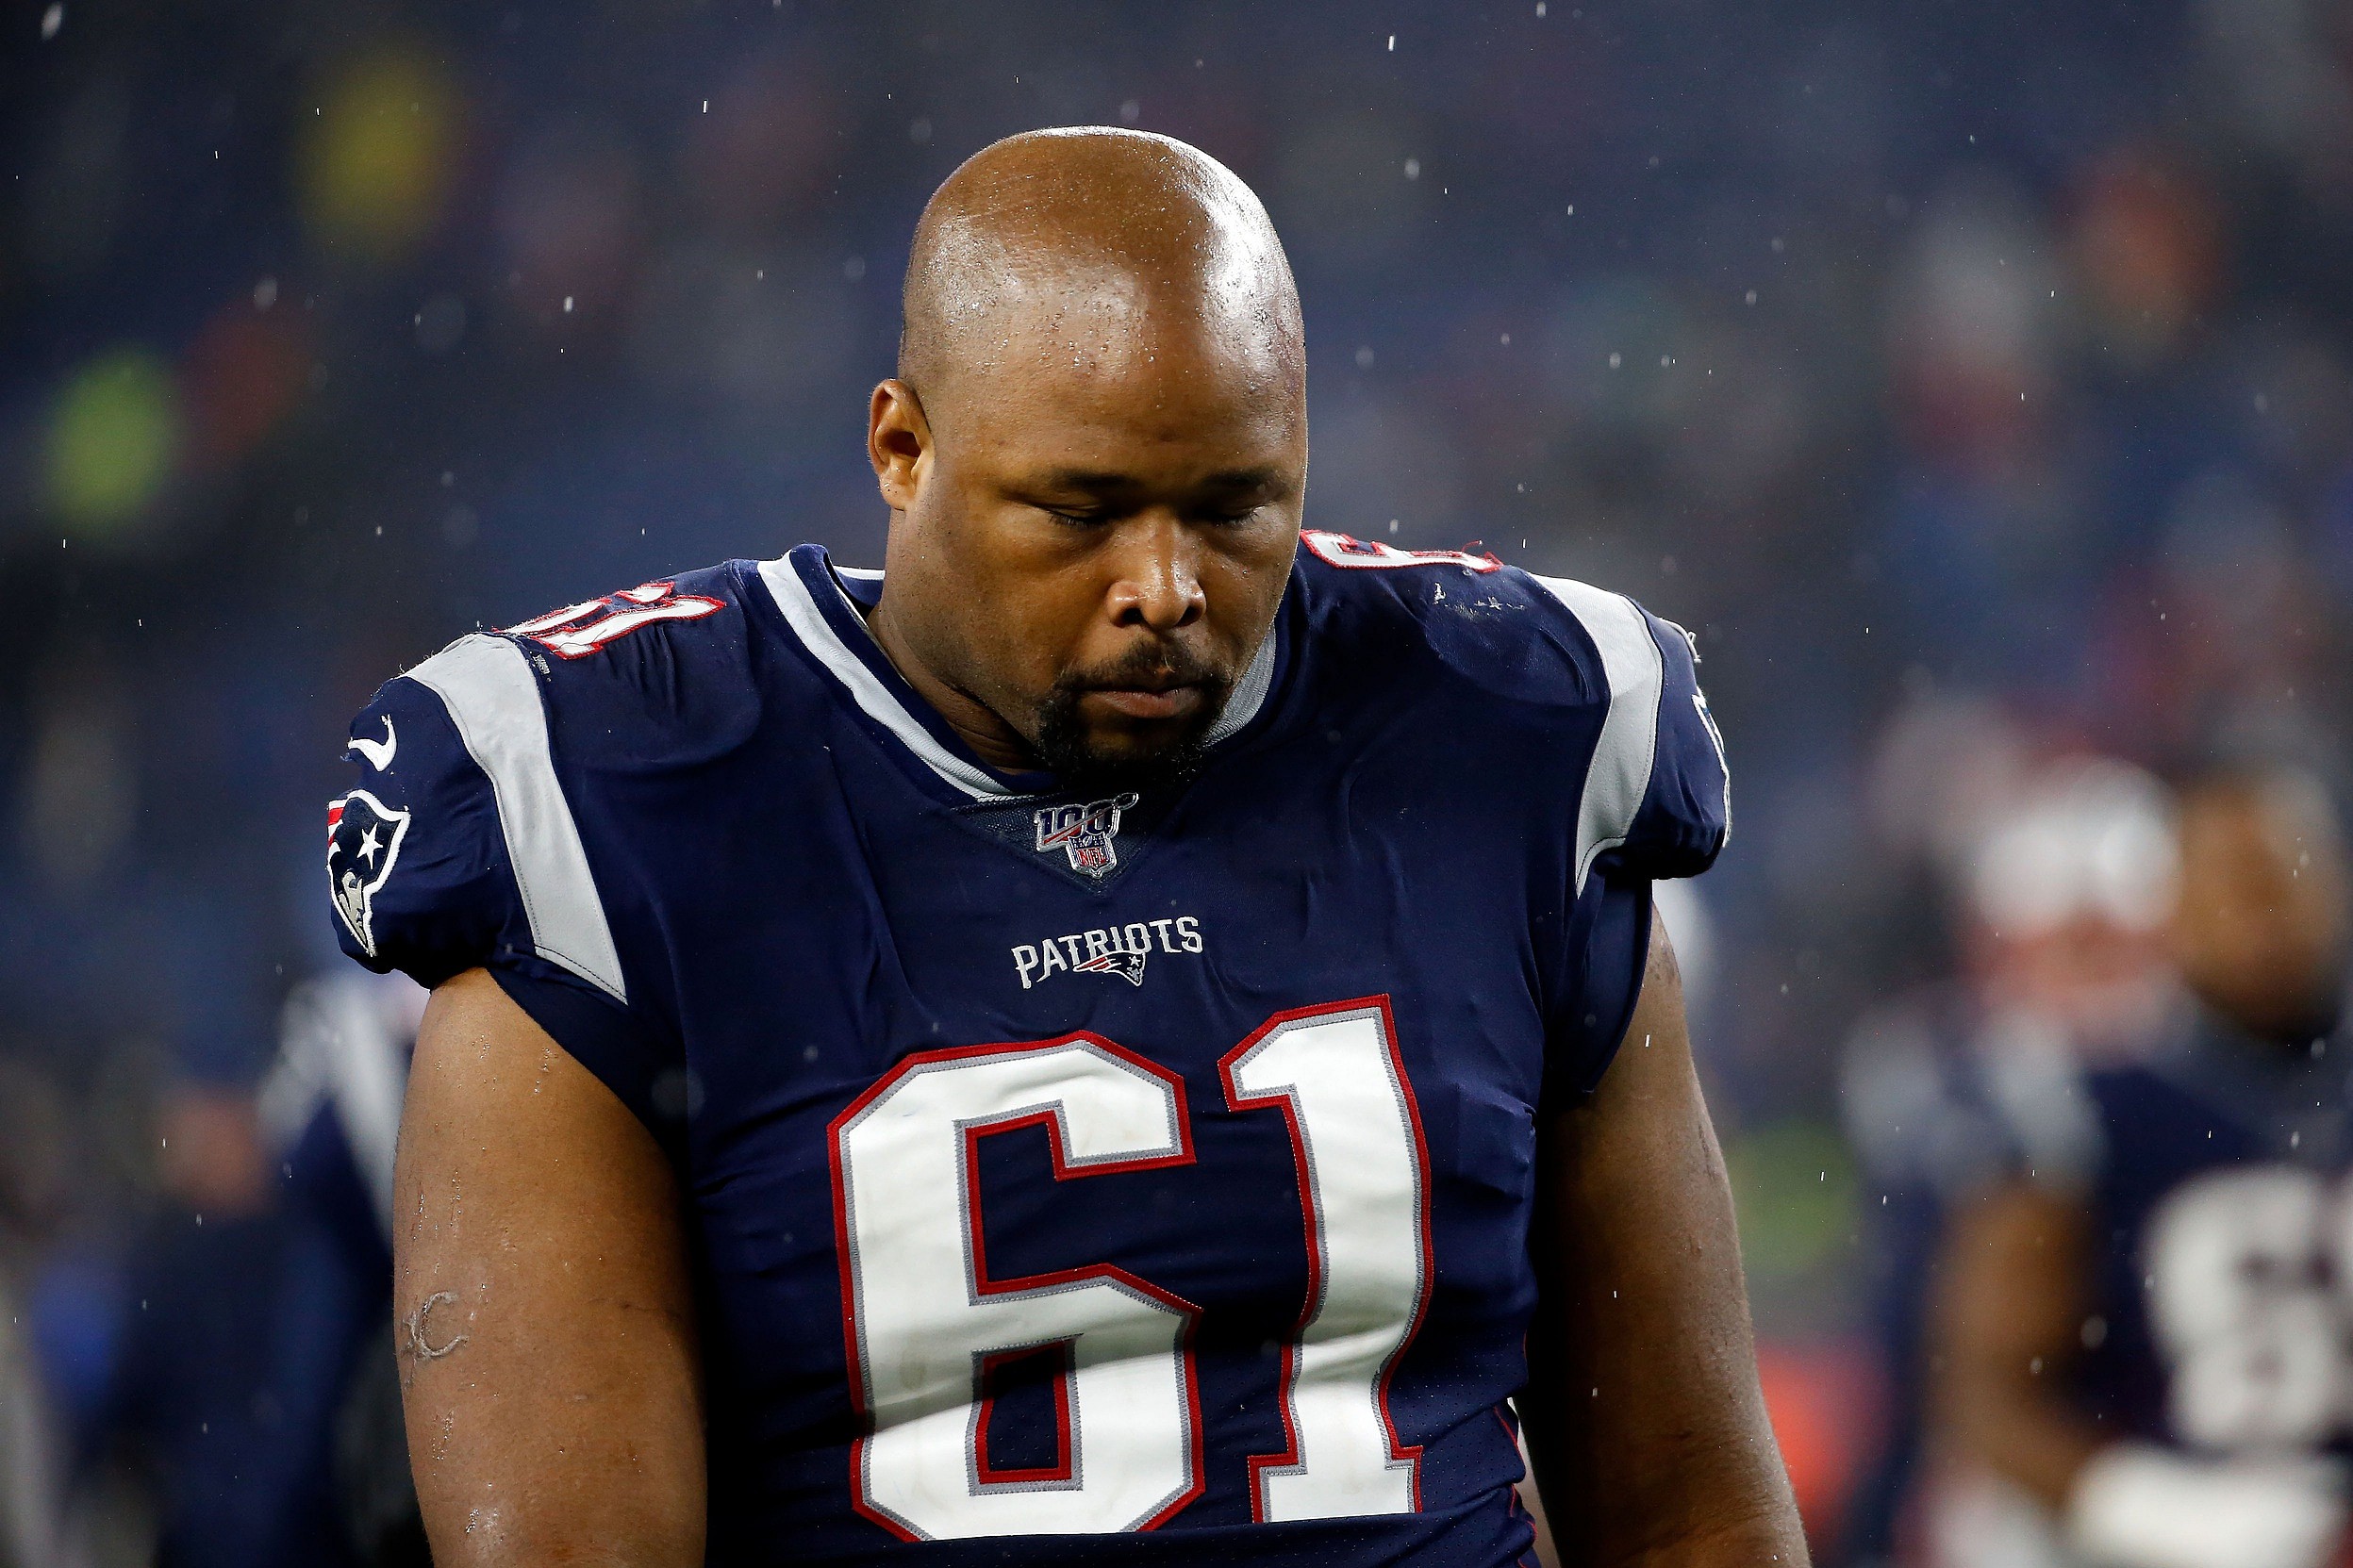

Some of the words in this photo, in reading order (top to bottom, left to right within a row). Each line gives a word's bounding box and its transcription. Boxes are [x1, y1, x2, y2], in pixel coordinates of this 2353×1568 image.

[1036, 801, 1120, 852] 100
[1076, 847, 1109, 867] NFL
[1011, 916, 1202, 988] PATRIOTS
[827, 994, 1433, 1542] 61
